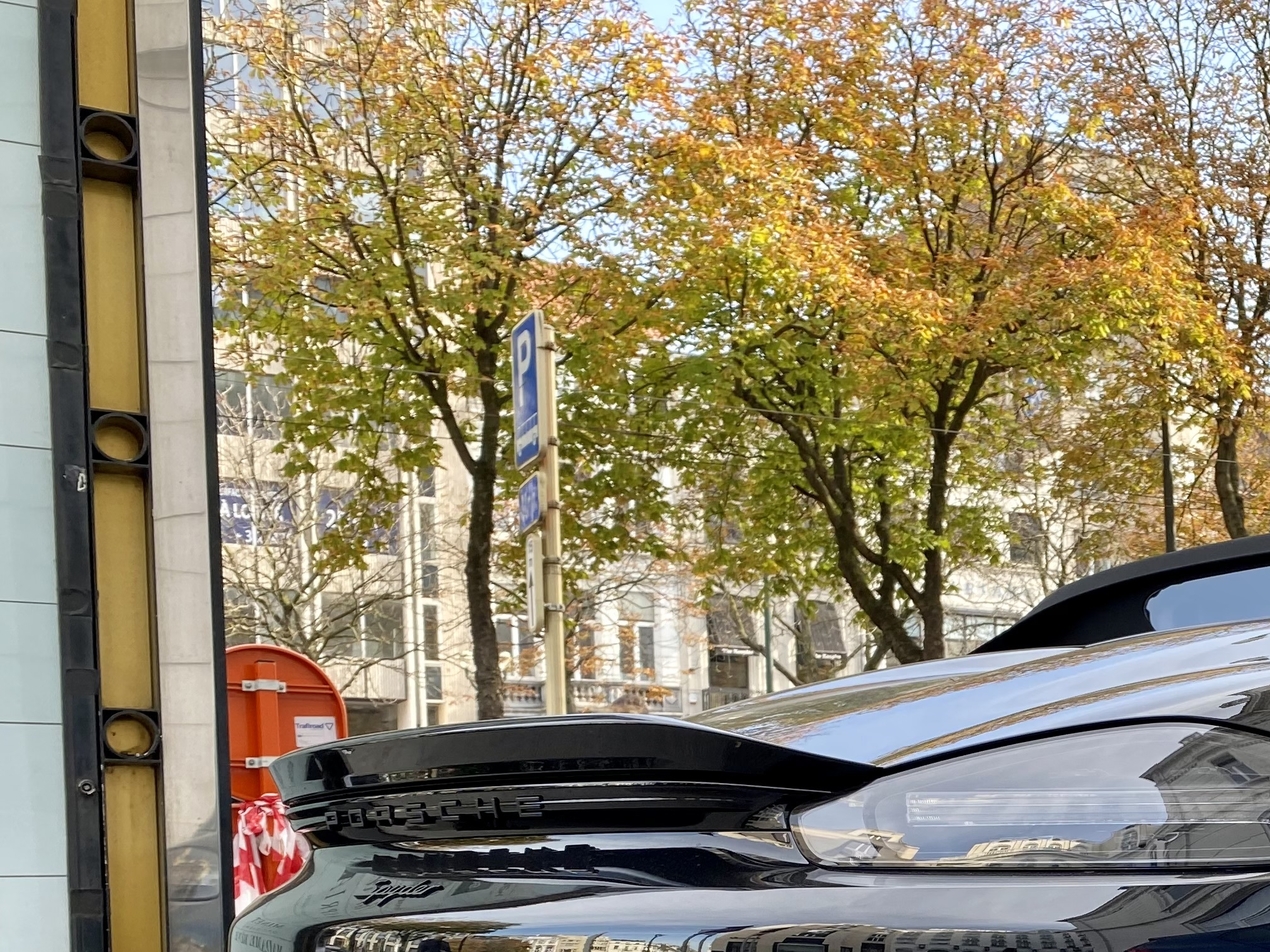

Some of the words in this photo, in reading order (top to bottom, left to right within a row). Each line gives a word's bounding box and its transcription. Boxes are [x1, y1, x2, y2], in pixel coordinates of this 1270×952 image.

[517, 329, 531, 407] P
[325, 795, 544, 828] PORSCHE
[354, 879, 445, 908] Spyder
